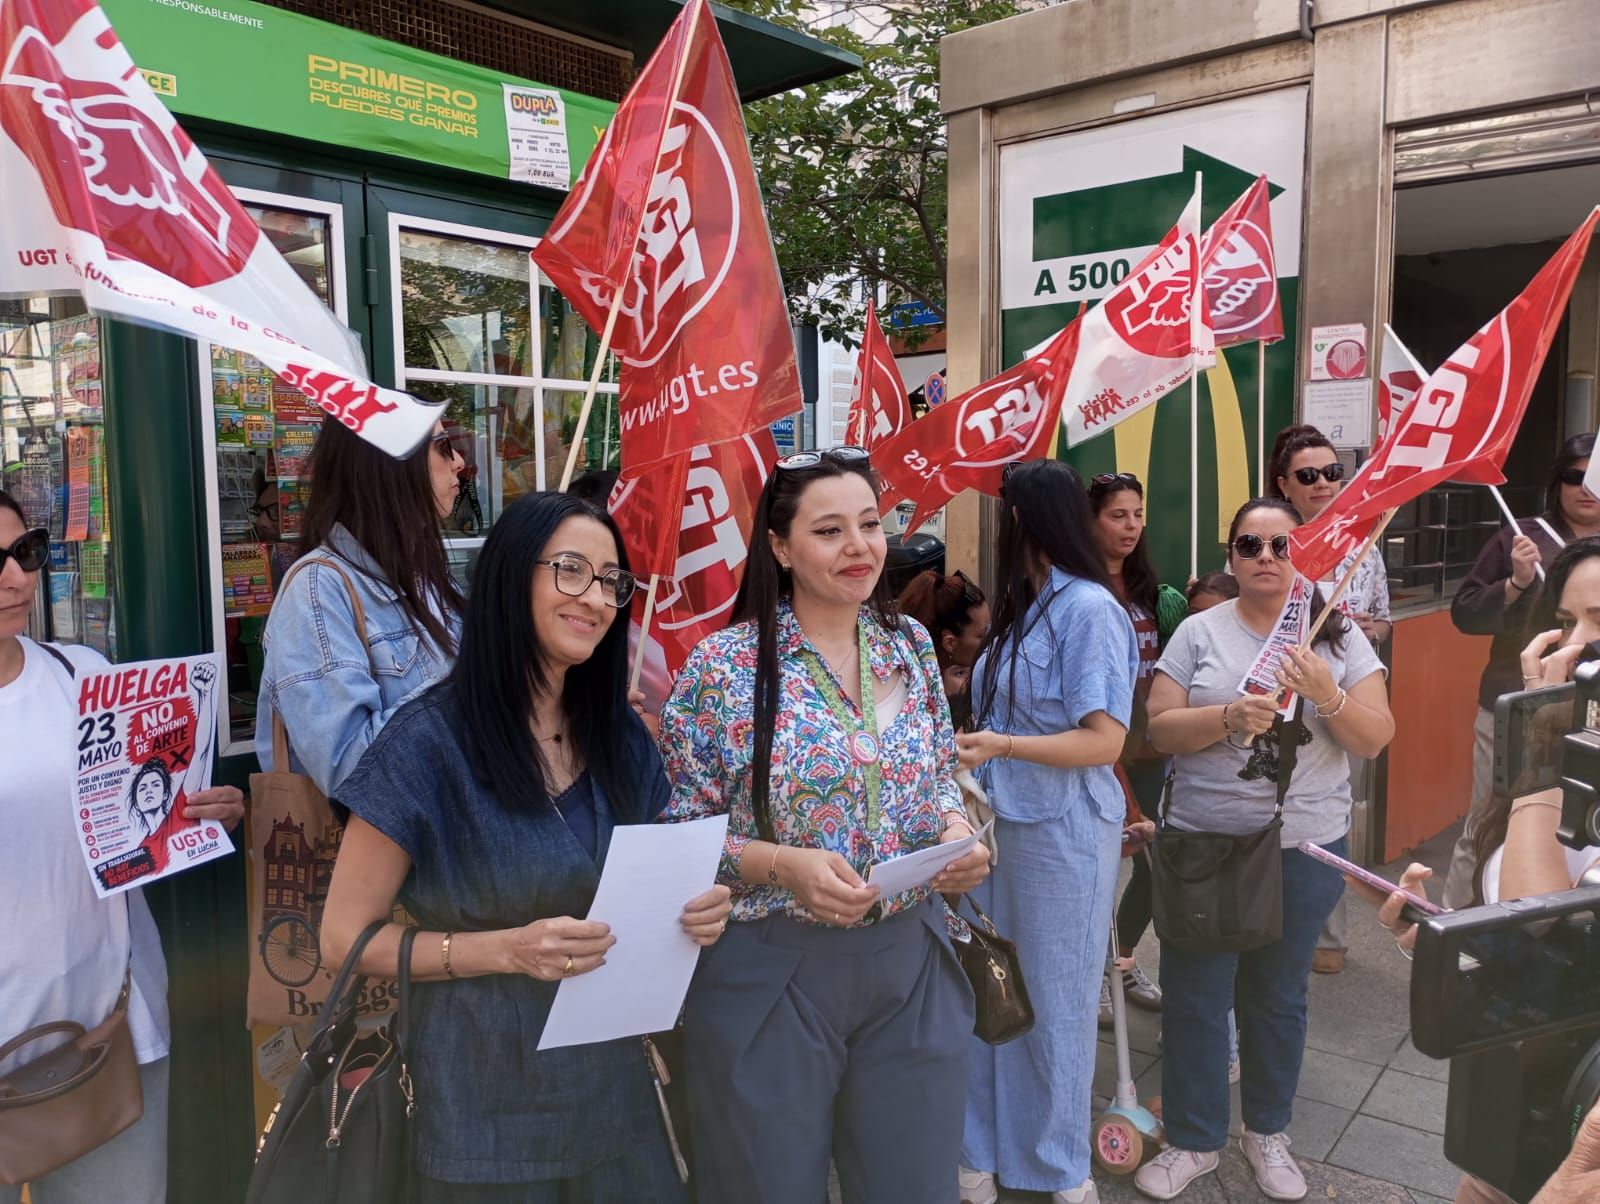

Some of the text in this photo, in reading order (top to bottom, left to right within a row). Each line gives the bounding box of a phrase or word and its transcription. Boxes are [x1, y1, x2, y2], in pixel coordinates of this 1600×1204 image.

[143, 73, 171, 91] CE
[308, 54, 478, 111] PRIMERO
[309, 77, 477, 125] DESCUBRES QUÉ PREMIOS
[310, 92, 478, 138] PUEDES GANAR
[18, 248, 57, 267] UGT
[1034, 259, 1130, 296] A 500
[192, 305, 217, 320] de
[230, 315, 249, 331] la
[771, 421, 794, 431] LINIC
[1283, 602, 1300, 622] 23
[79, 662, 188, 715] HUELGA
[78, 711, 116, 752] 23
[133, 715, 189, 746] AL CONVENIO
[141, 702, 174, 732] NO
[136, 725, 189, 756] DE ARTE
[78, 741, 122, 771] MAYO
[78, 767, 131, 787] POR UN CONVENIO
[78, 777, 123, 795] JUSTO Y DIGNO
[172, 830, 206, 851] UGT
[187, 840, 219, 858] EN LUCHA
